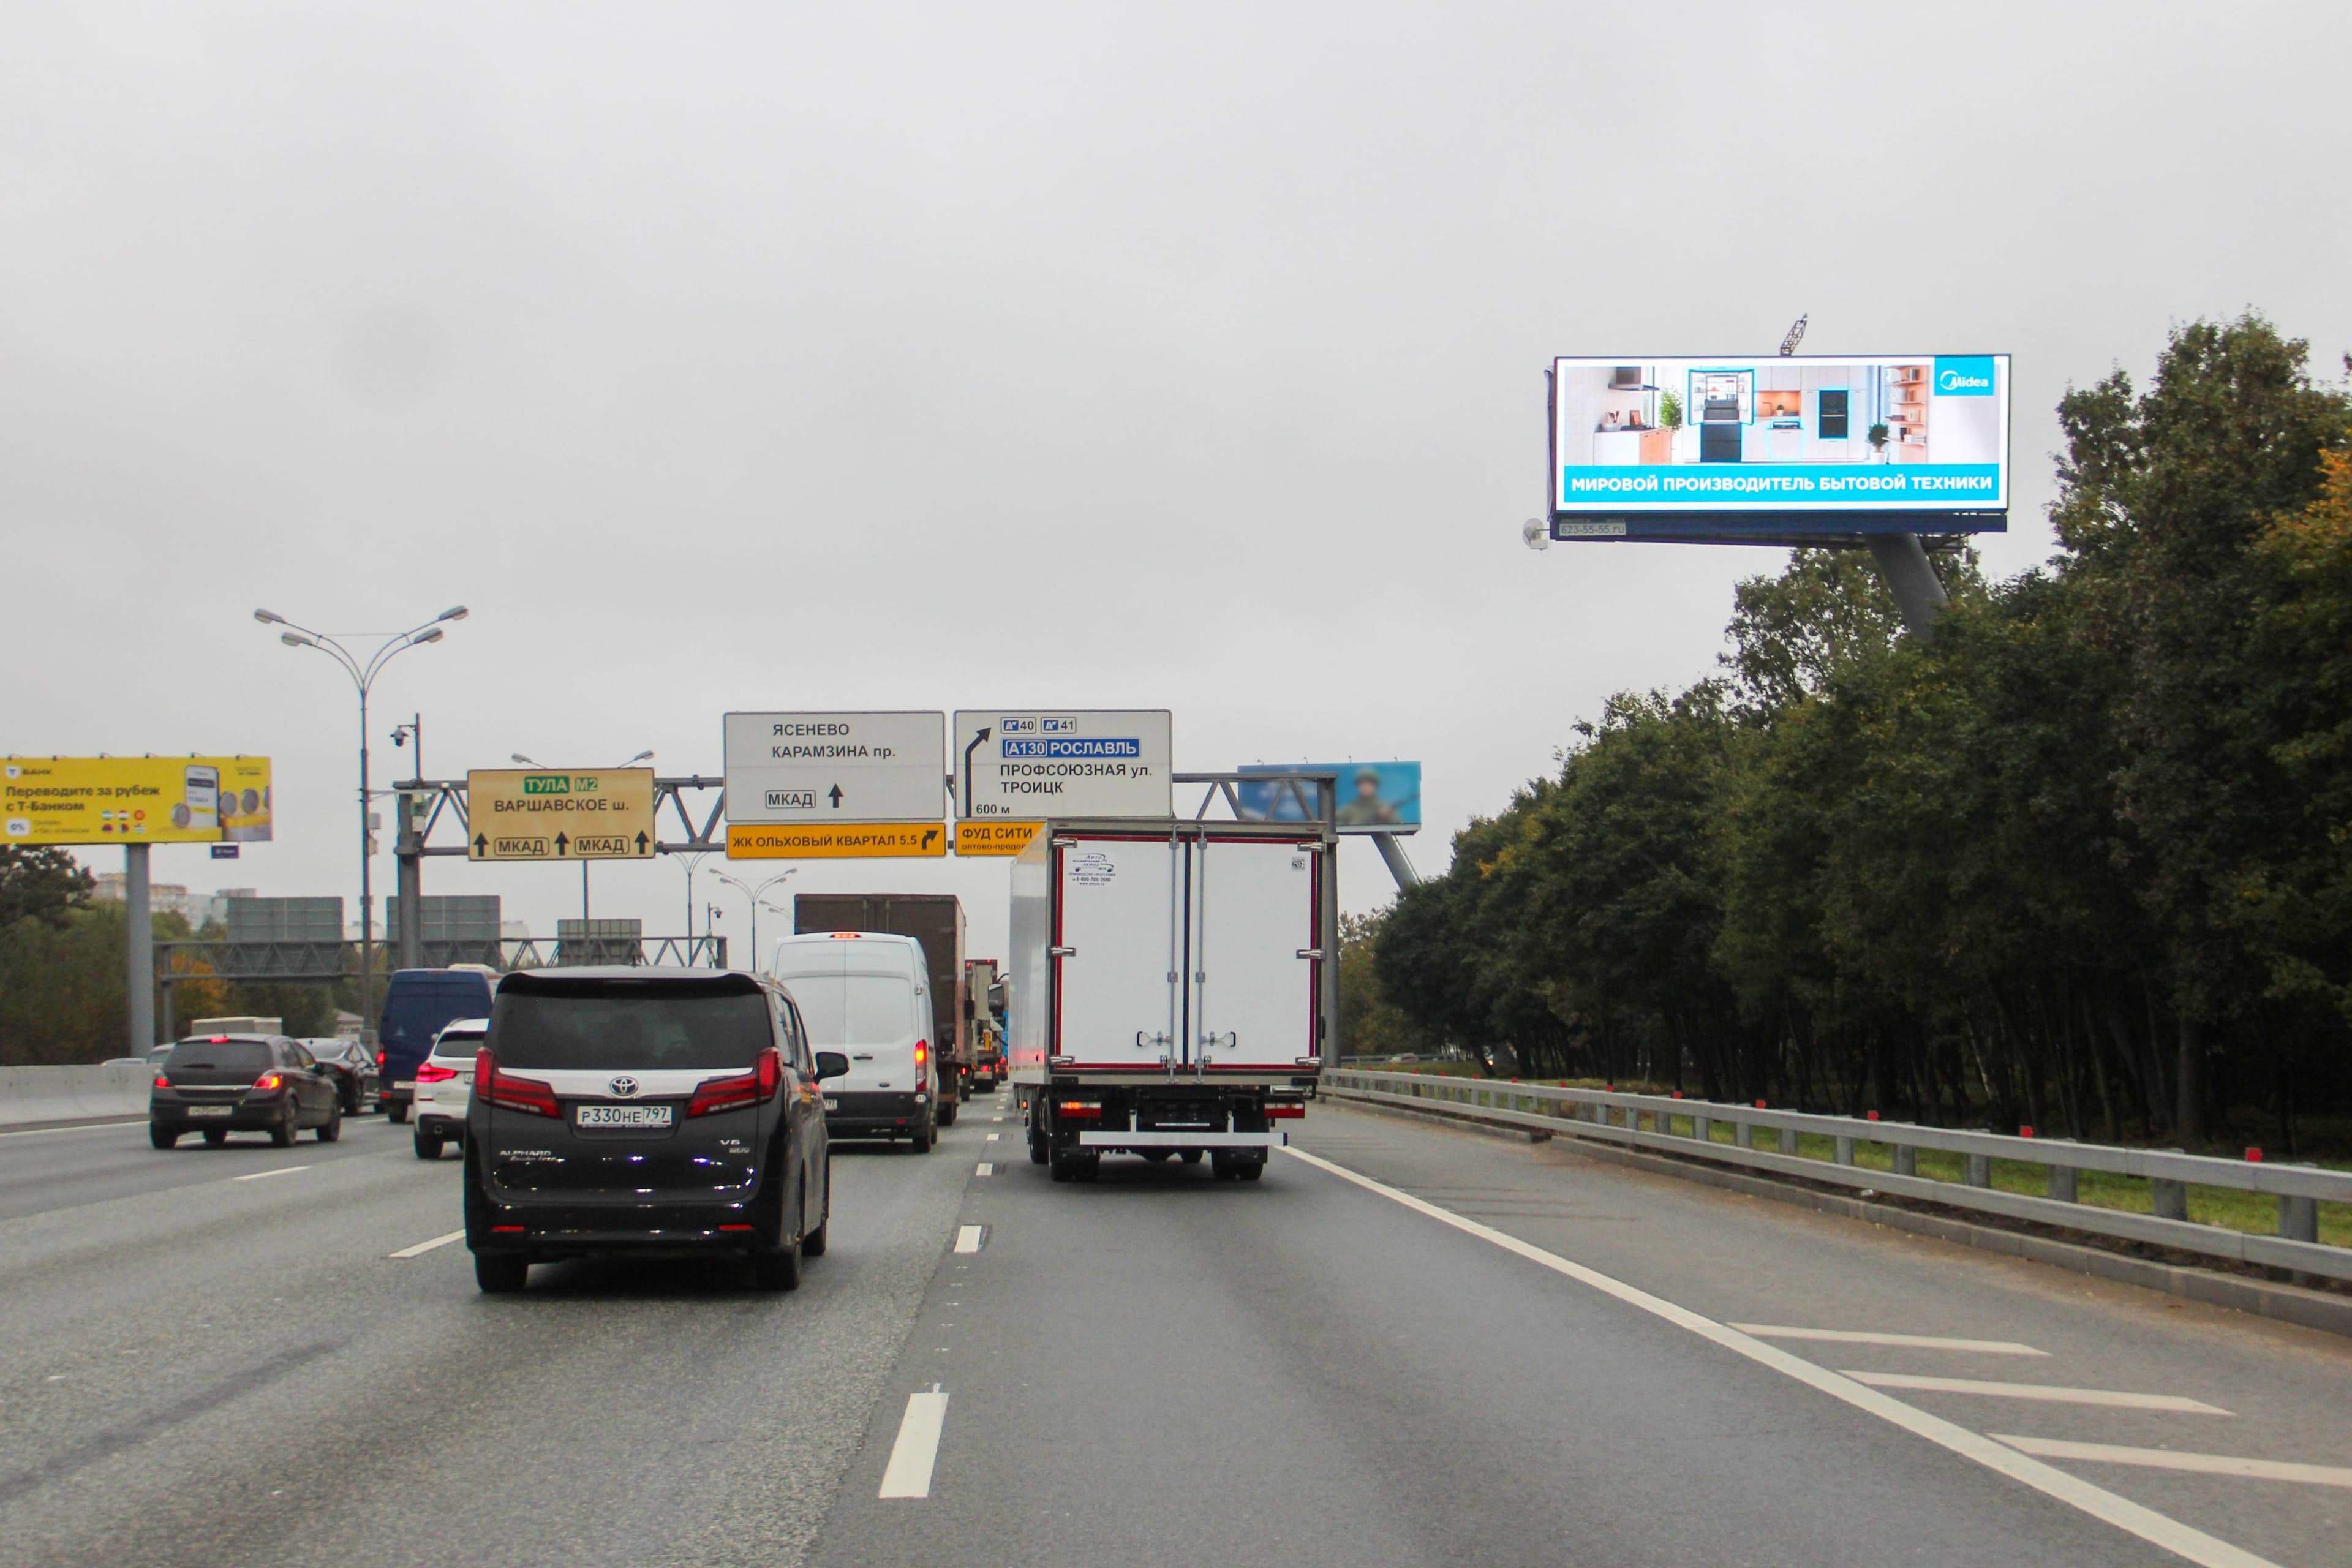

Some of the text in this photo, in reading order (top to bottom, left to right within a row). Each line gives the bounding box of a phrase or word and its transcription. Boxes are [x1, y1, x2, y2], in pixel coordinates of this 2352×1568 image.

[1940, 370, 1989, 390] Midea
[1572, 473, 1992, 492] МИРОВОЙ ПРОИЗВОДИТЕЛЬ БЫТОВОЙ ТЕХНИКИ
[773, 724, 850, 736] ЯСЕНЕВО
[1020, 721, 1034, 730] 40
[1061, 720, 1074, 730] 41
[772, 745, 896, 760] КАРАМЗИНА пр.
[1008, 741, 1137, 755] А130 РОСЛАВЛЬ
[1000, 764, 1152, 778] ПРОФСОЮЗНАЯ ул.
[6, 786, 94, 799] Переводите
[116, 785, 160, 797] рубеж
[526, 778, 597, 792] ТУЛА М2
[1001, 782, 1063, 795] ТРОИЦК
[6, 801, 85, 812] с Т-Банком
[494, 799, 629, 812] ВАРШАВСКОЕ ш.
[768, 793, 813, 808] МКАД
[976, 805, 997, 814] 600
[962, 827, 1032, 840] ФУД СИТИ
[499, 840, 545, 855] МКАД
[579, 839, 625, 854] МКАД
[733, 834, 917, 848] ЖК ОЛЬХОВЫЙ КВАРТАЛ 5.5
